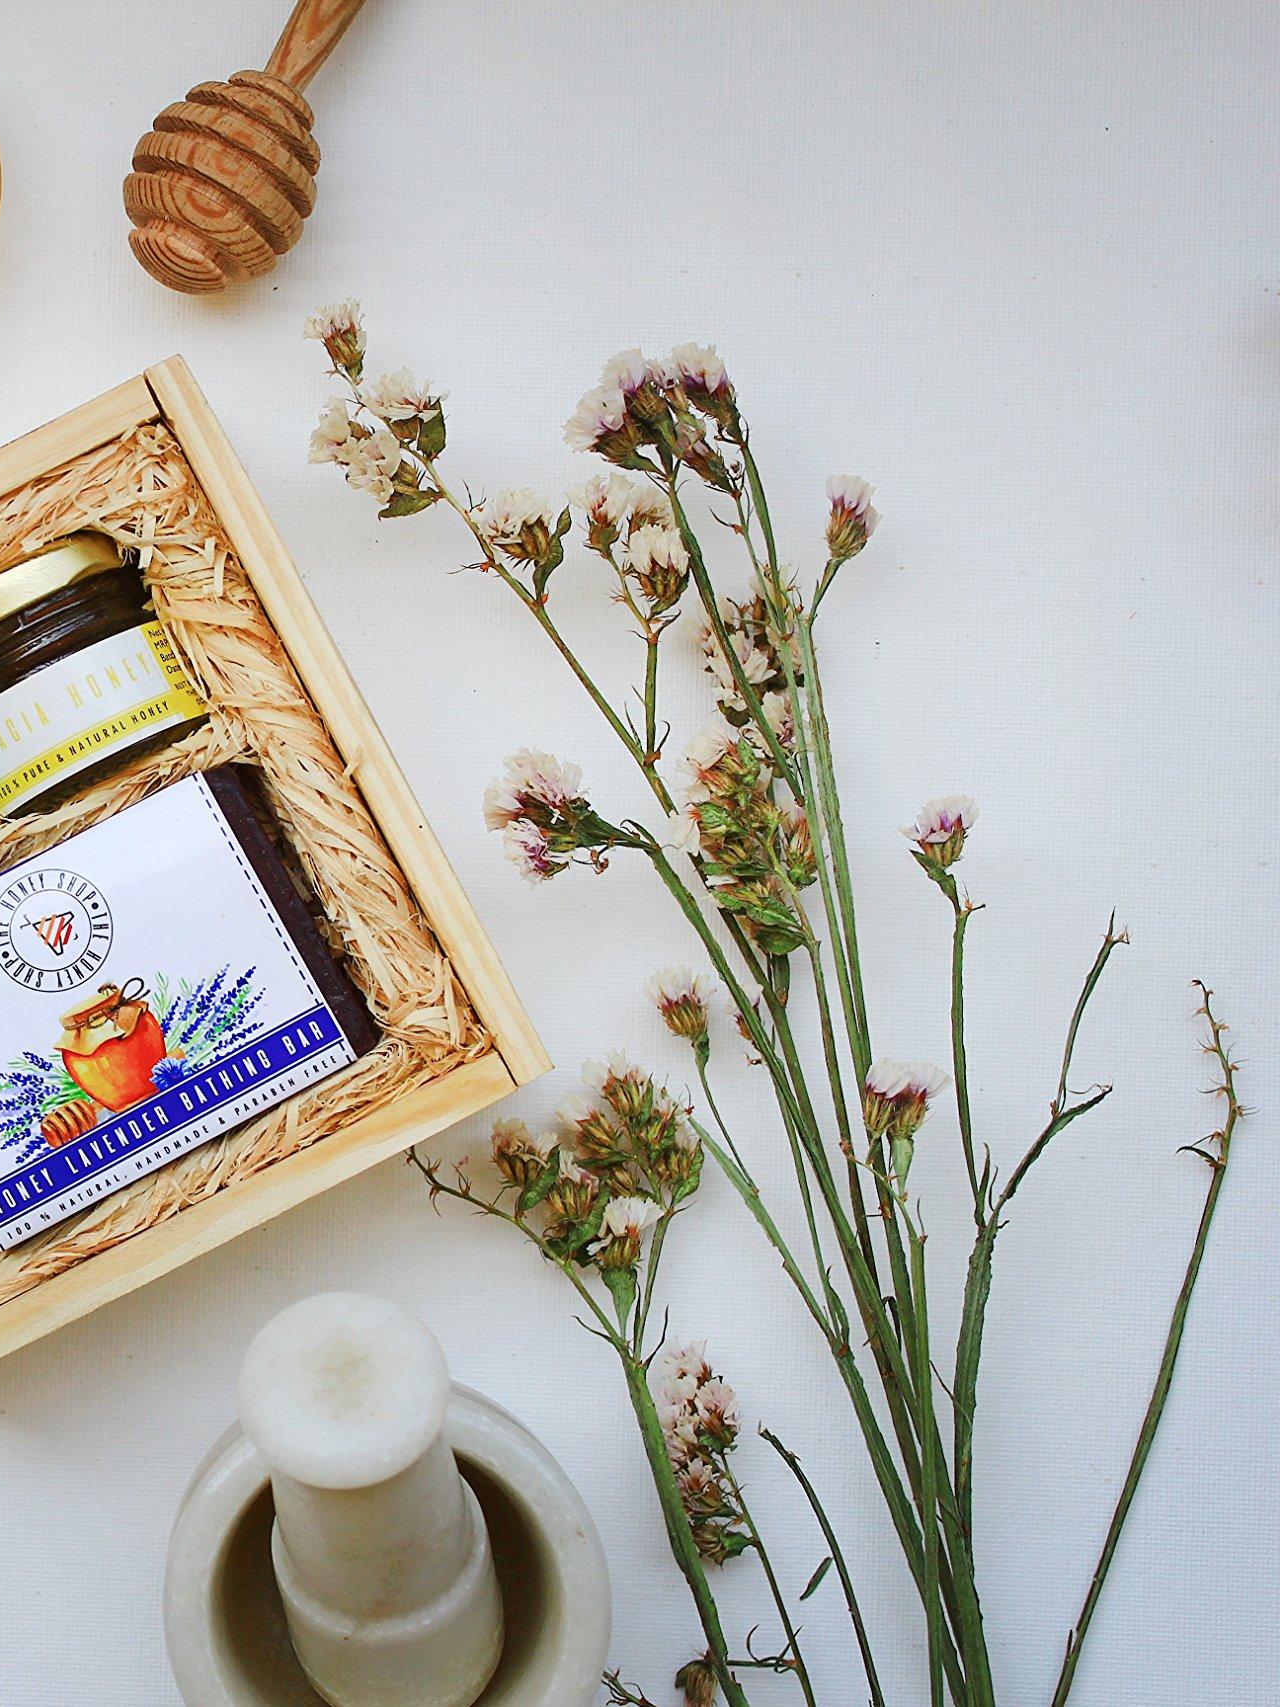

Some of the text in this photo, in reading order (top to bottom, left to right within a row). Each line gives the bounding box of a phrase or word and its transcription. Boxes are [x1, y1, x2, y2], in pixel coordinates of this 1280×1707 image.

[66, 651, 152, 708] HONEY
[22, 760, 51, 782] PURE
[56, 753, 65, 763] &
[68, 720, 127, 756] NATURAL
[131, 700, 171, 725] HONEY
[0, 872, 45, 912] HONEY
[57, 872, 97, 902] SHOP
[4, 912, 109, 989] THE HONEY SHOP
[64, 1105, 170, 1174] LAVENDER
[179, 1049, 271, 1111] BATHING
[281, 1020, 324, 1056] BAR
[6, 1055, 337, 1240] 100 % NATURAL, HANDMADE & PARABEN FREE
